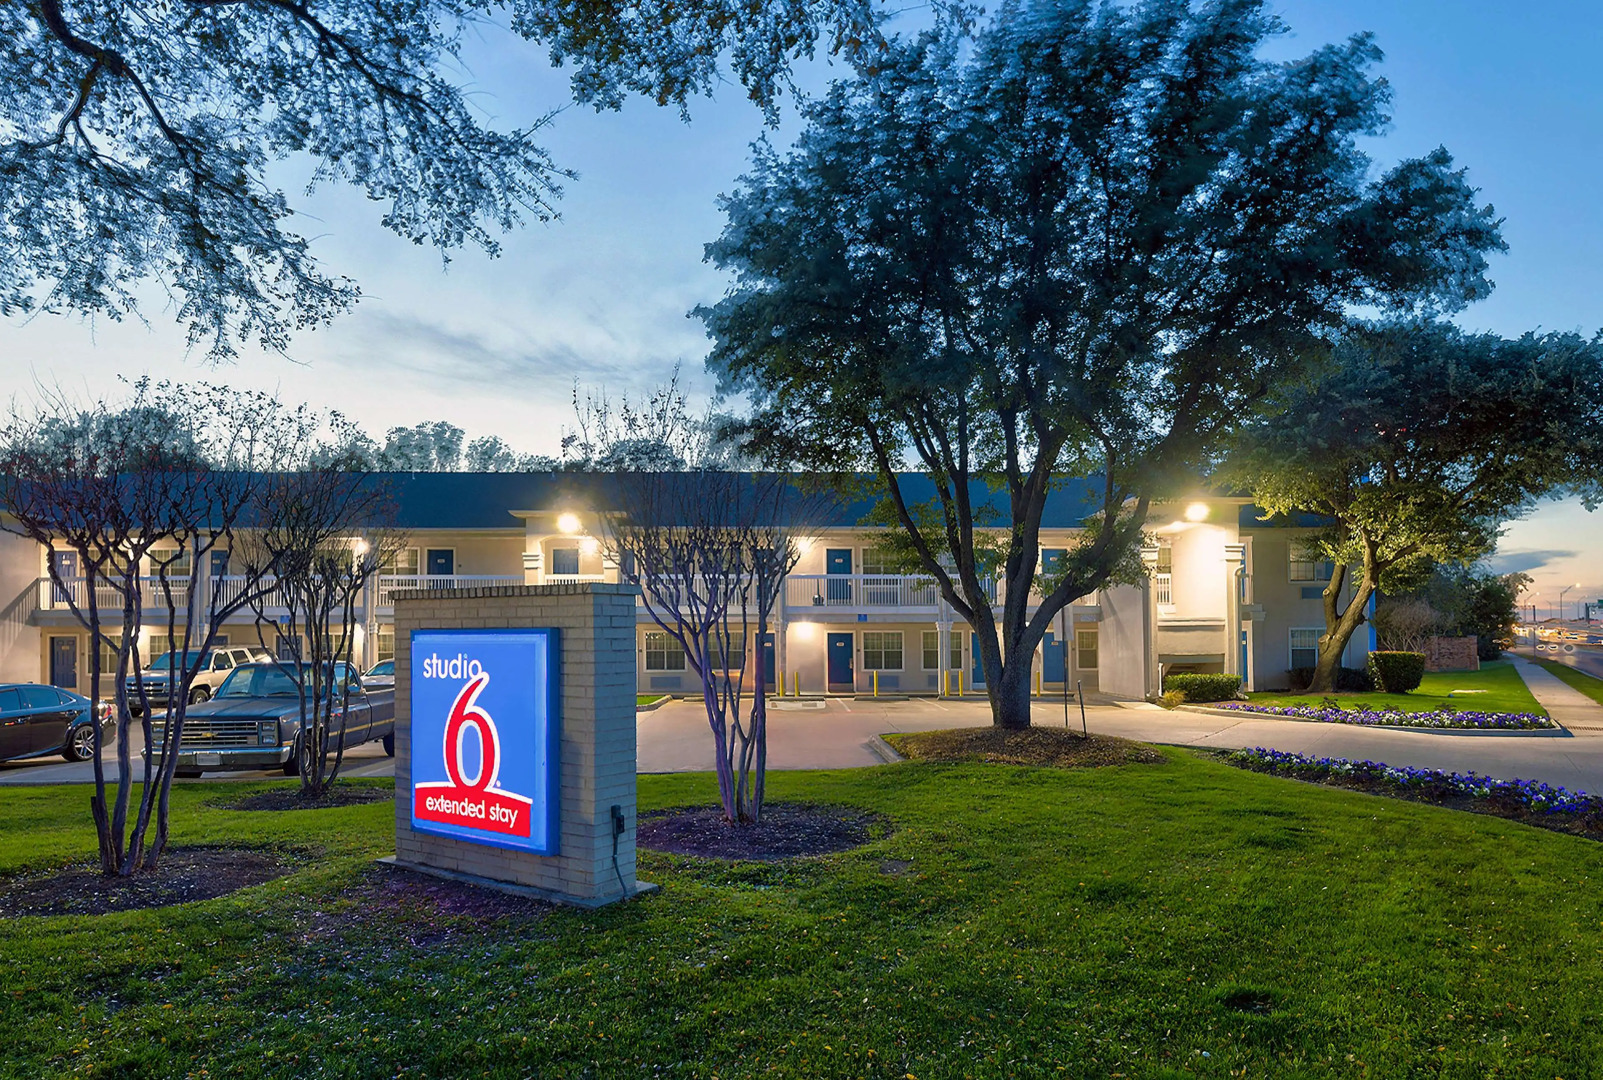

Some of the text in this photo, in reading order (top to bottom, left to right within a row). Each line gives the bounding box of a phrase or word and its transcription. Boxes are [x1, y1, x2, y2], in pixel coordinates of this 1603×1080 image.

[423, 653, 482, 679] studio
[443, 671, 500, 789] 6
[425, 795, 518, 828] extended stay
